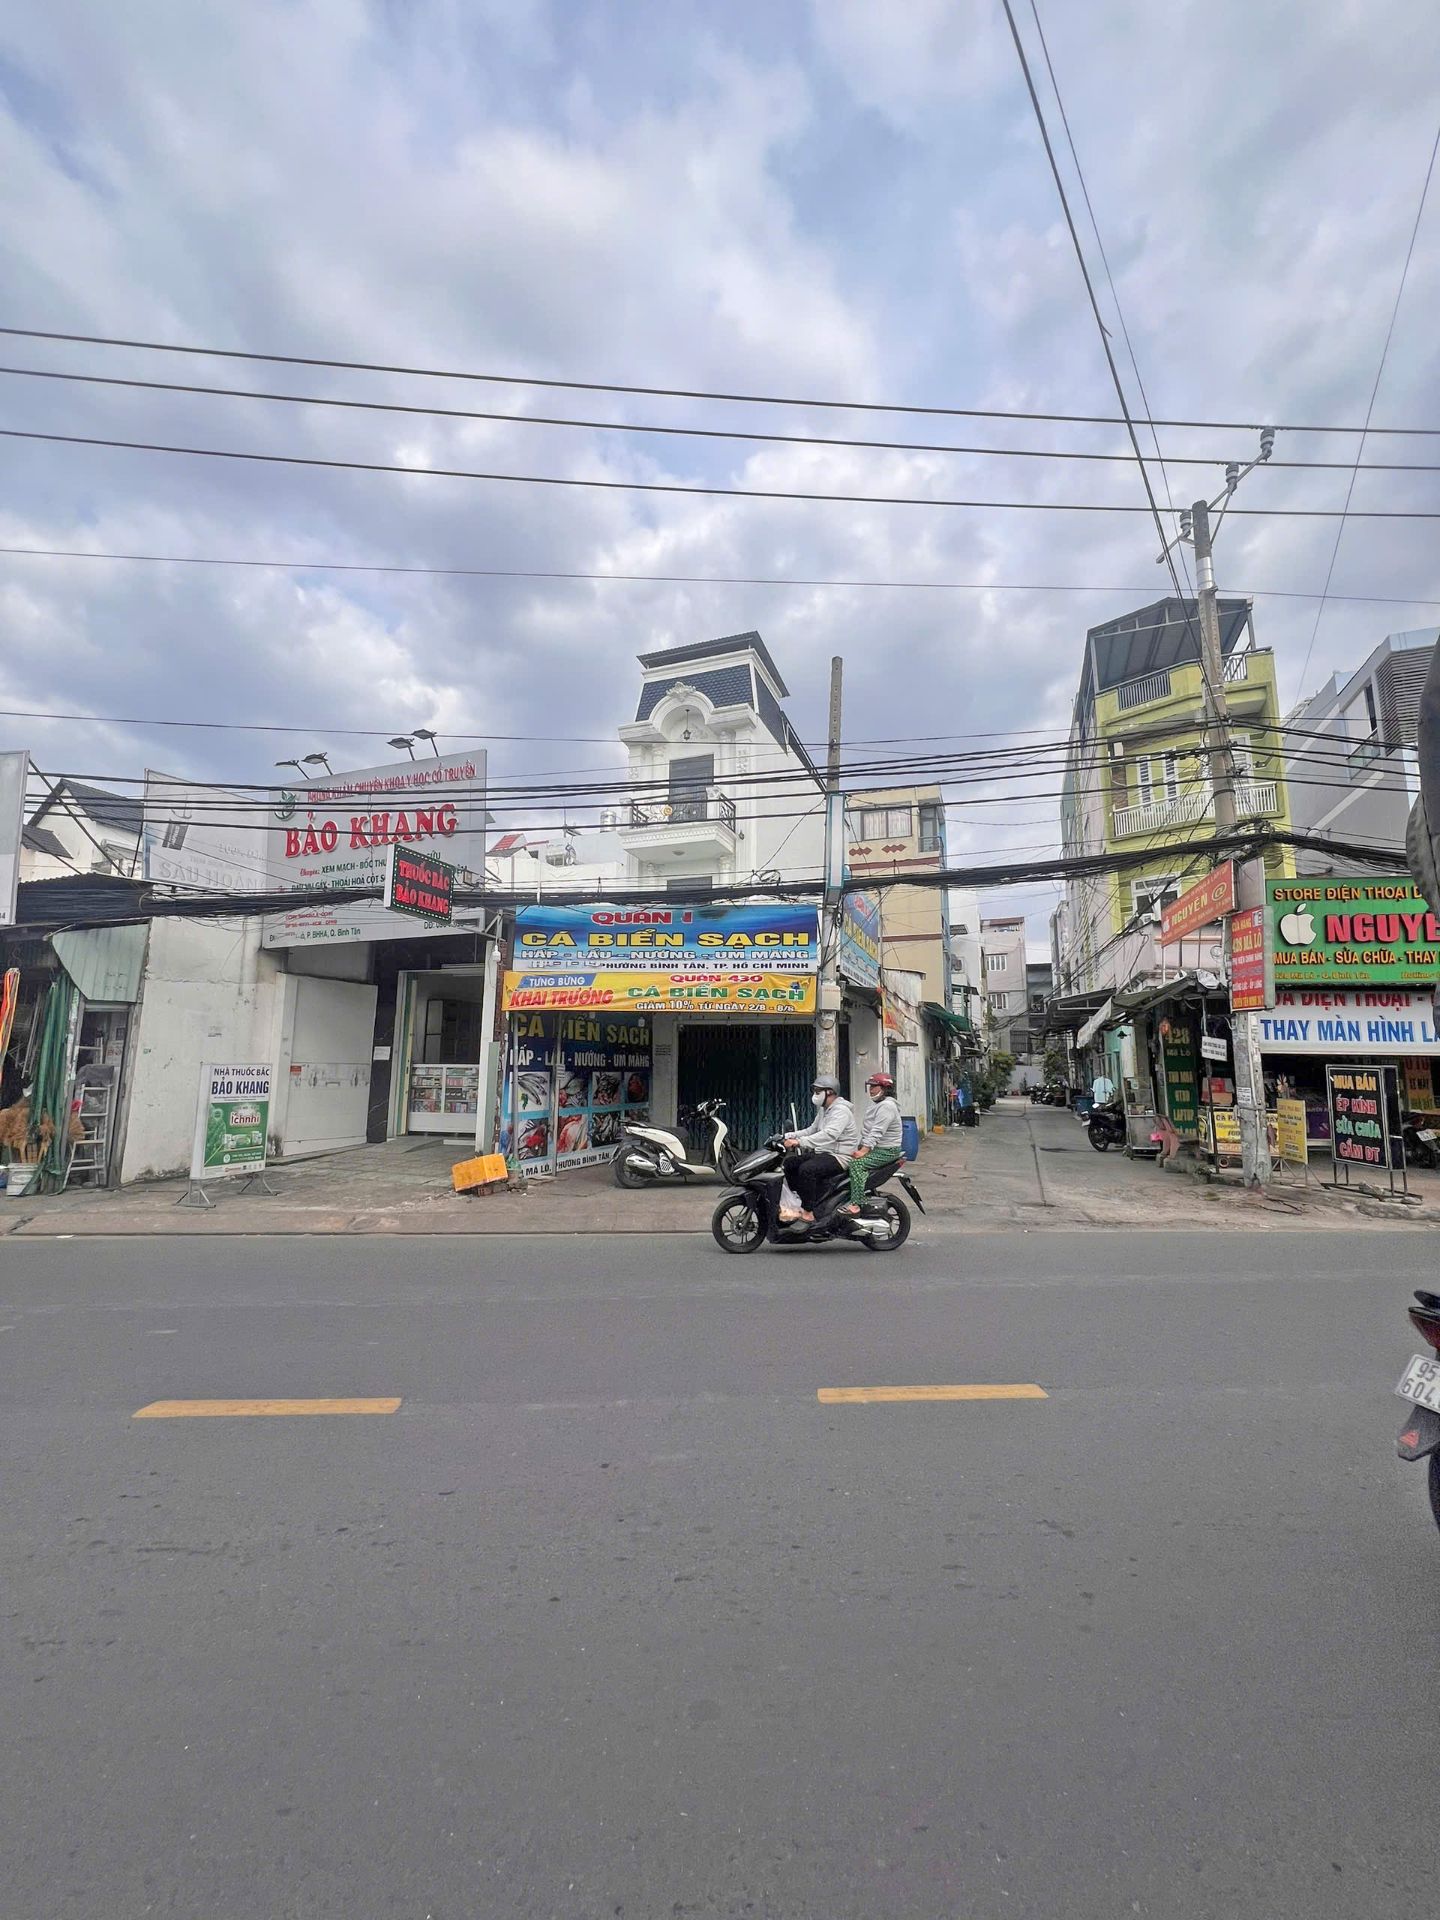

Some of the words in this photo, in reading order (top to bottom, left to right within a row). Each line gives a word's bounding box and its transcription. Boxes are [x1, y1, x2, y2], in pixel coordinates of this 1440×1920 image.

[384, 774, 405, 790] KHOA
[405, 774, 412, 787] Y
[413, 771, 431, 788] HỌC
[443, 760, 477, 782] TRUYỀN
[285, 810, 338, 858] BẢO
[350, 803, 458, 850] KHANG
[321, 865, 335, 874] XEM
[336, 862, 355, 873] MẠCH
[374, 859, 387, 868] THU
[399, 859, 431, 885] THUỐC
[432, 865, 450, 891] BẮC
[396, 881, 417, 906] BẢO
[418, 890, 449, 915] KHANG
[1274, 887, 1321, 901] STORE
[1327, 884, 1361, 902] ĐIỆN
[1365, 886, 1409, 901] THOẠI
[592, 909, 672, 925] QUÁN
[521, 930, 577, 947] CÁ
[588, 927, 685, 947] BIỂN
[697, 931, 810, 949] SẠCH
[521, 948, 558, 959] HẤP
[630, 947, 697, 960] NƯỚNG
[751, 949, 809, 960] MĂNG
[1274, 951, 1297, 965] MUA
[1300, 948, 1326, 965] BÁN
[1336, 946, 1360, 965] SỬA
[1363, 947, 1397, 965] CHỮA
[1406, 951, 1437, 965] THAY
[650, 961, 679, 969] BÌNH
[529, 977, 555, 987] TƯNG
[558, 975, 585, 986] BỪNG
[728, 974, 764, 983] 430
[509, 989, 548, 1008] KHAI
[551, 986, 614, 1007] TRƯƠNG
[627, 985, 661, 998] CÁ
[669, 984, 728, 999] BIỂN
[737, 988, 806, 1001] SẠCH
[670, 1000, 694, 1010] 10%
[715, 1003, 746, 1012] NGÀY
[748, 1004, 767, 1012] 2/8
[607, 1024, 650, 1048] SẠCH
[1260, 1019, 1311, 1041] THAY
[1317, 1014, 1361, 1041] MÀN
[1367, 1014, 1414, 1042] HÌNH
[574, 1050, 606, 1068] NƯỚNG
[214, 1067, 230, 1076] NHÀ
[231, 1065, 256, 1076] THUỐC
[256, 1066, 270, 1076] BẮC
[212, 1077, 233, 1095] BẢO
[236, 1080, 269, 1094] KHANG
[1333, 1075, 1354, 1090] MUA
[1355, 1073, 1377, 1091] BÁN
[1352, 1096, 1377, 1115] KÍNH
[1402, 1377, 1440, 1408] 604.
